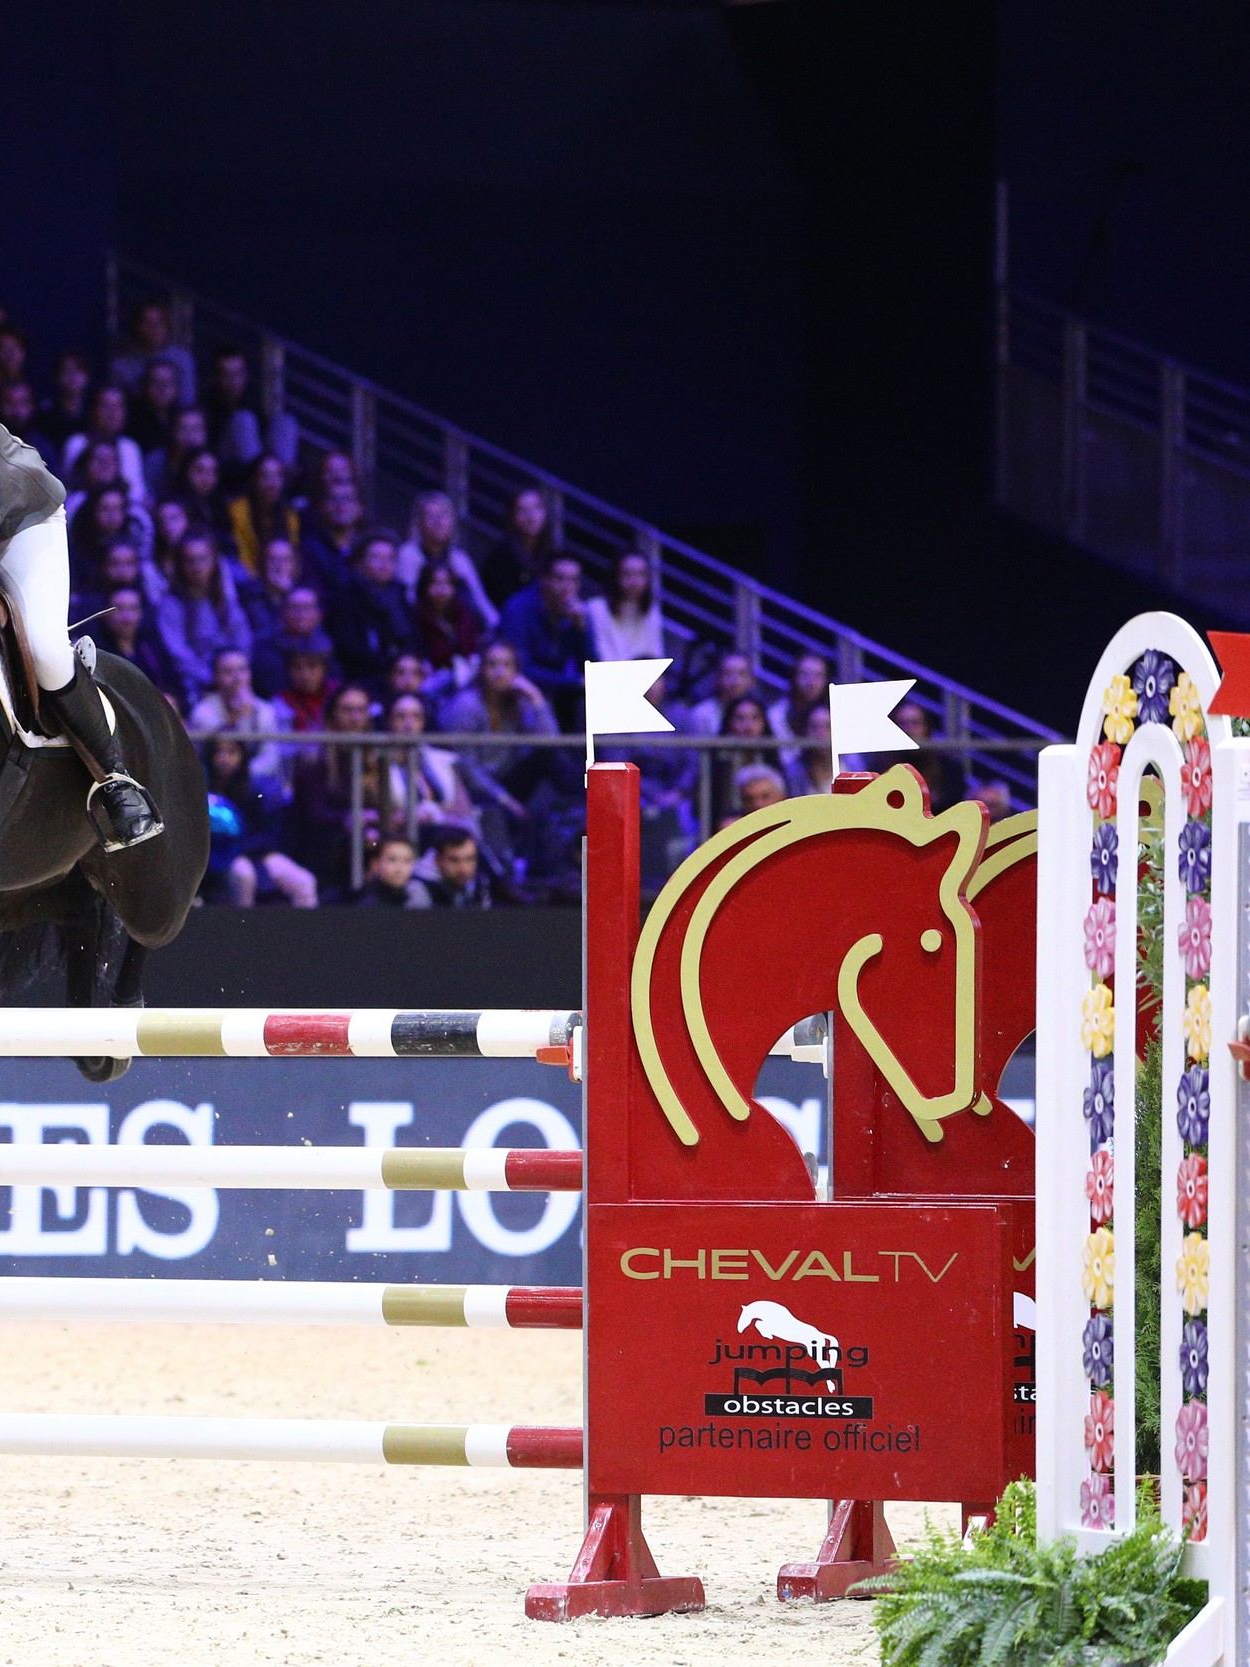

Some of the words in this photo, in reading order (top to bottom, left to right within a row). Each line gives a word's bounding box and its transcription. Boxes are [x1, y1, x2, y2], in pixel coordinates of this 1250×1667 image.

[708, 1338, 870, 1368] jumping
[723, 1396, 854, 1416] obstacles
[659, 1422, 812, 1454] partenaire
[823, 1424, 920, 1453] officiel
